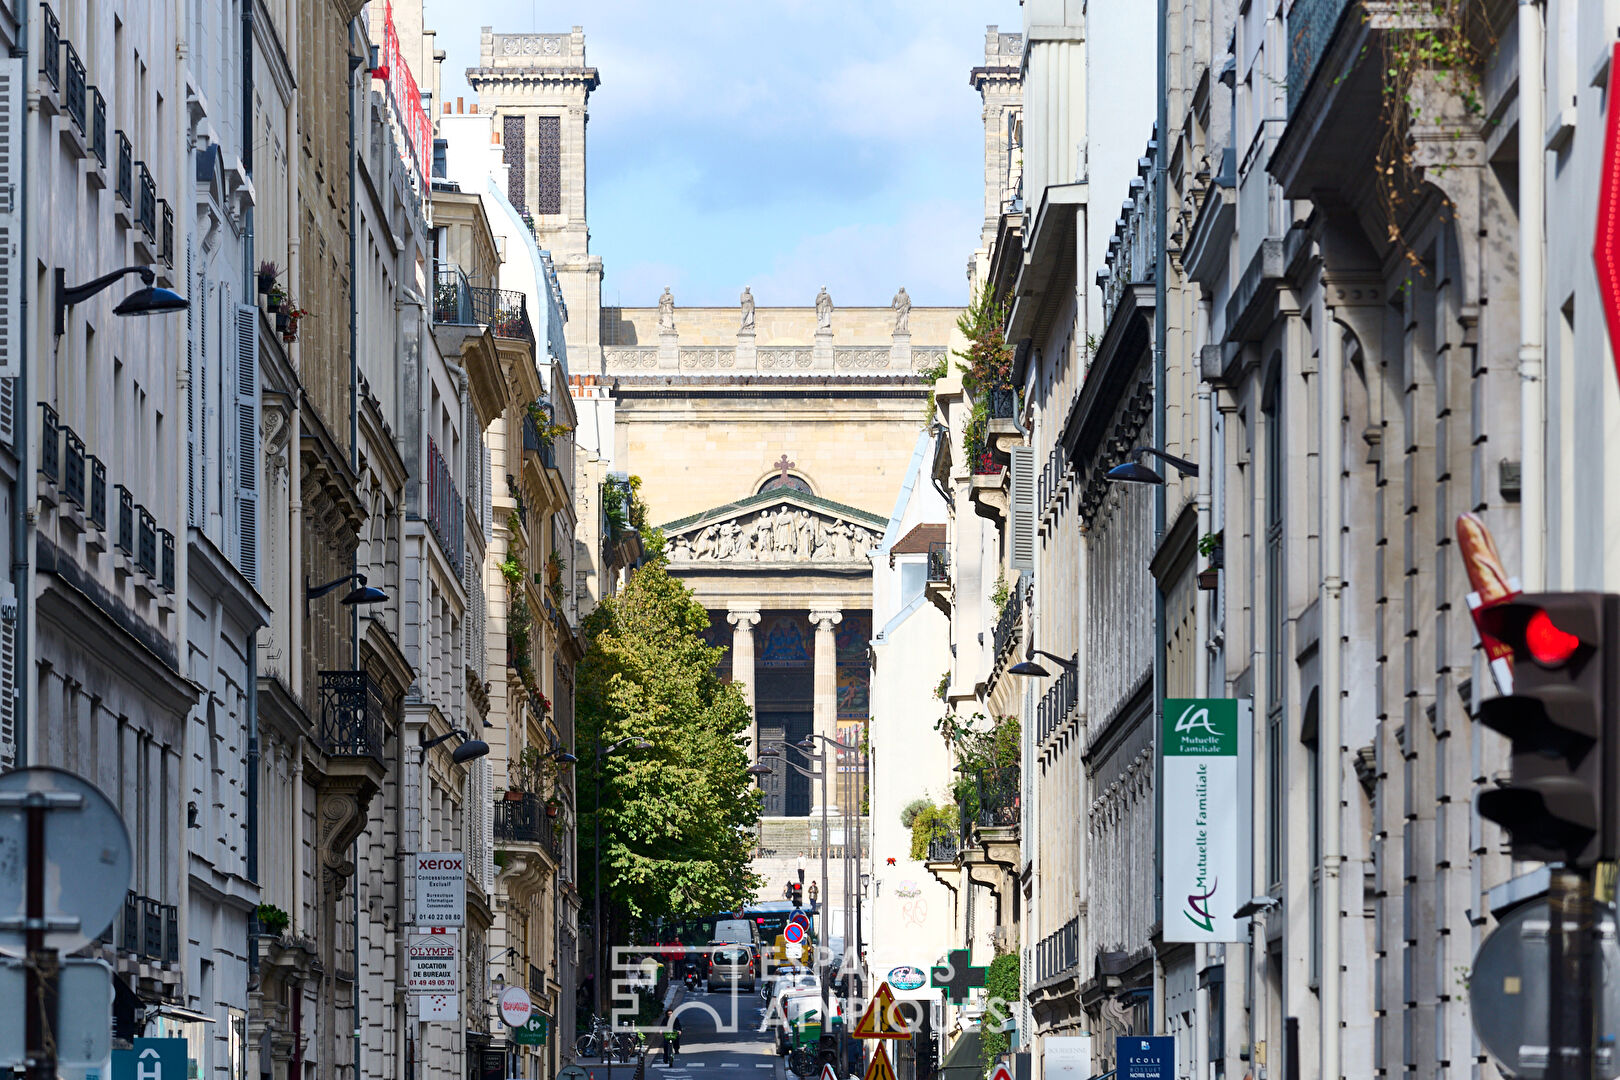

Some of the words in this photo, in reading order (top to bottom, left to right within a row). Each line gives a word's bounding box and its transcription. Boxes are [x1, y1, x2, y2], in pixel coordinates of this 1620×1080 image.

[1181, 736, 1220, 744] Mutuelle
[1179, 745, 1222, 753] Familiale
[1195, 763, 1209, 826] Familiale
[1195, 829, 1208, 888] Mutuelle
[418, 859, 463, 870] xerox
[409, 947, 454, 956] OLYMPE
